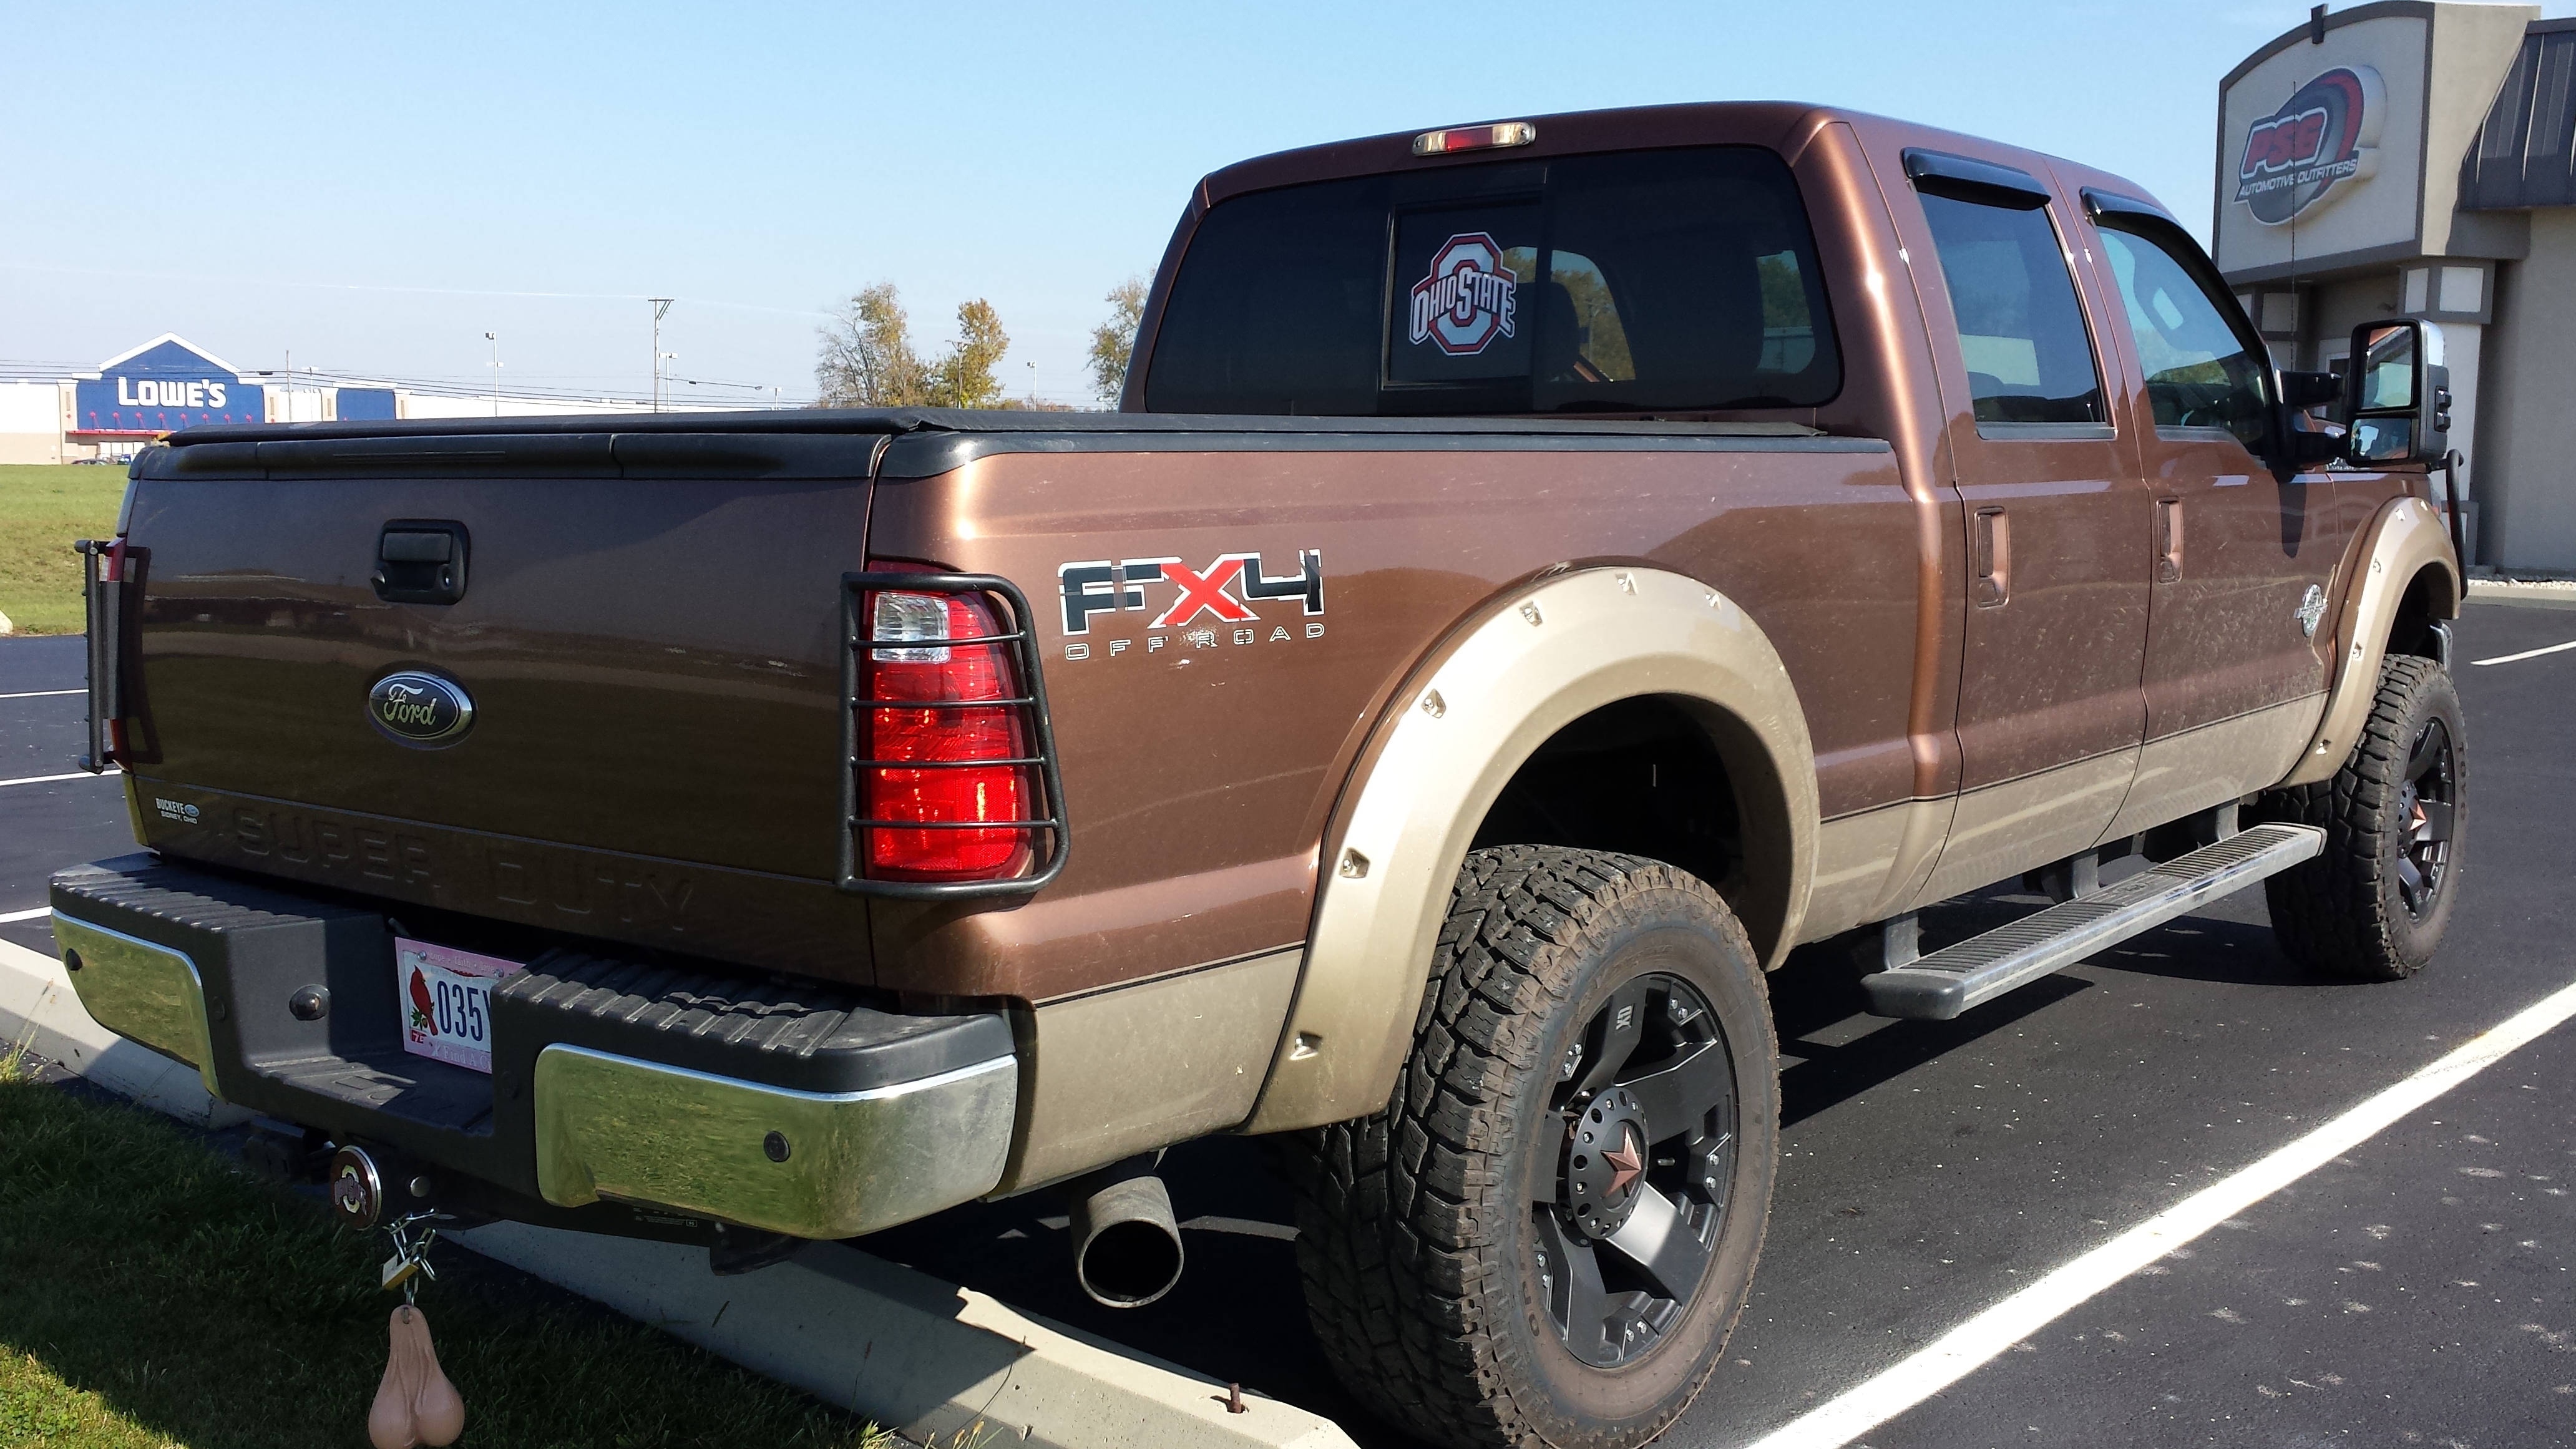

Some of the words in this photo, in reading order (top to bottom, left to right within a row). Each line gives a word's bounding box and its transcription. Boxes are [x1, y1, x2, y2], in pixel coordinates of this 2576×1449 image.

[2238, 173, 2295, 197] AUTOMOTIVE
[2297, 158, 2358, 185] OUTFITTERS
[117, 376, 227, 408] LOWE'S
[1058, 549, 1324, 636] FX4
[1196, 622, 1326, 649] ROAD
[383, 683, 437, 726] Ford
[155, 798, 185, 814] BUCKEYE
[183, 816, 198, 824] OHIO
[232, 806, 442, 890] SUPER
[487, 849, 695, 933] DUTY
[454, 957, 471, 968] faith
[481, 962, 495, 972] love
[443, 1045, 466, 1063] Find
[469, 1053, 477, 1067] A
